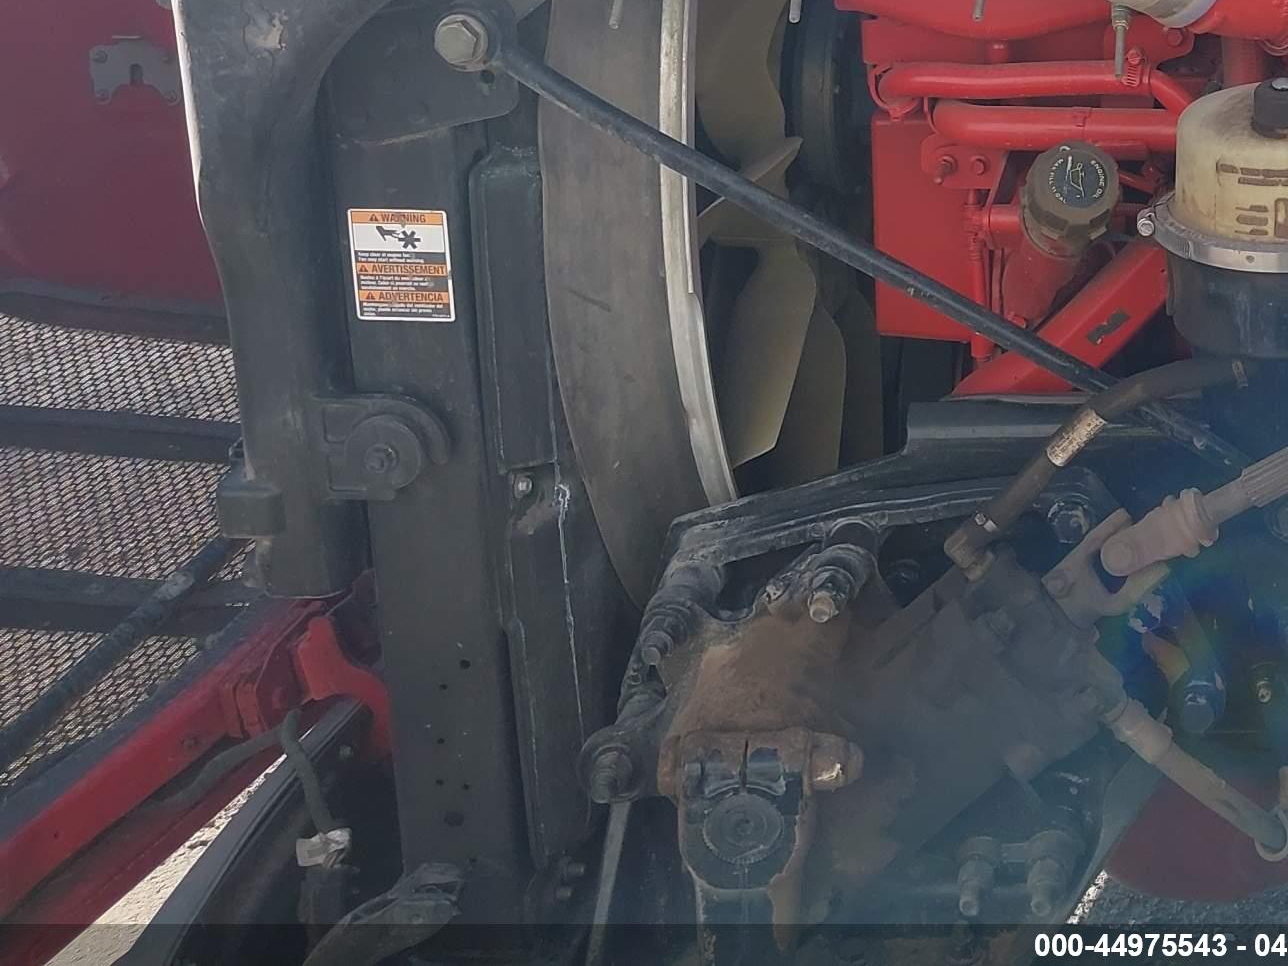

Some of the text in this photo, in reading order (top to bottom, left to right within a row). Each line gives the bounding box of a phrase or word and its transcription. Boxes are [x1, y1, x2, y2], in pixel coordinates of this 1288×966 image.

[1090, 160, 1105, 187] ENGINE
[371, 264, 445, 275] AVERTISSEMENT
[378, 291, 444, 302] ADVERTENCIA
